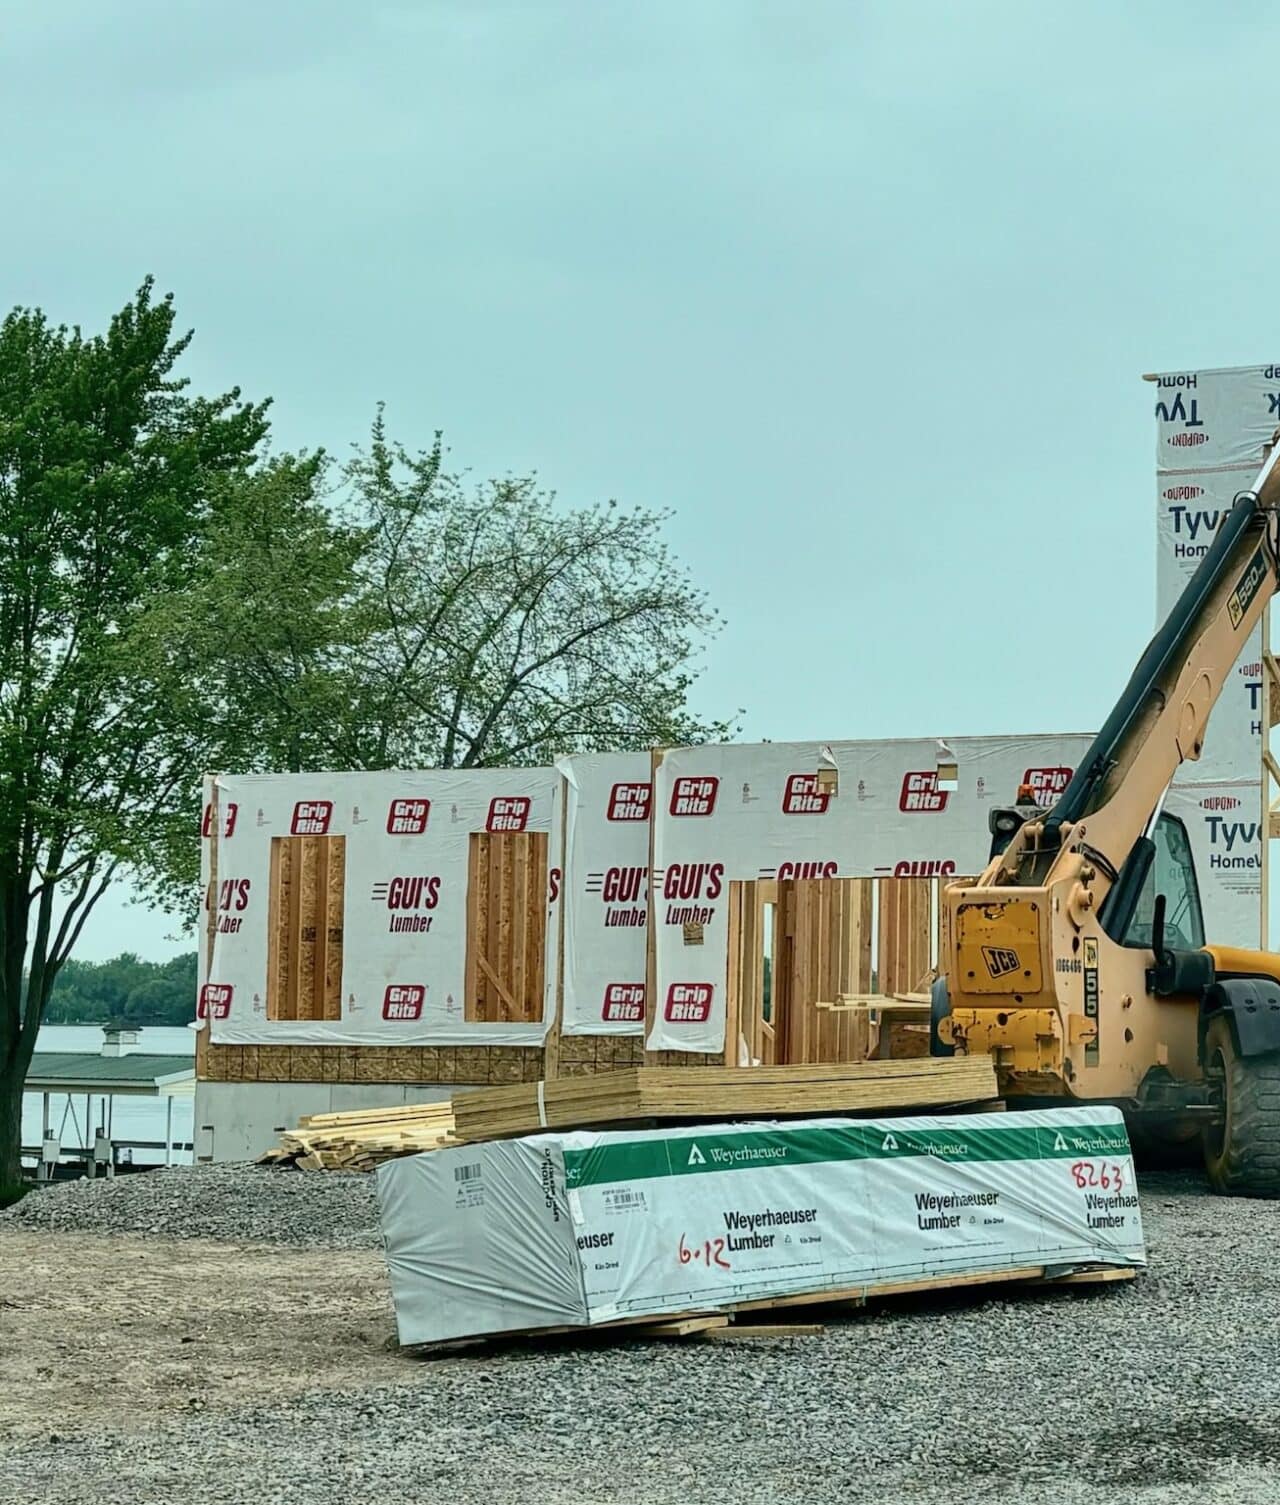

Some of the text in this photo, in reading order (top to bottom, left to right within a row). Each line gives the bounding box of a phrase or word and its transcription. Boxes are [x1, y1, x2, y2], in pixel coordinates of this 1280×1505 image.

[1167, 486, 1200, 500] DUPONT
[1168, 505, 1219, 540] Tyv
[678, 780, 713, 798] Grip
[791, 776, 818, 793] Gri
[908, 774, 939, 793] Gri
[1029, 771, 1067, 790] Grip
[615, 785, 650, 804] Grip
[789, 793, 823, 811] Rite
[906, 792, 940, 810] Rite
[1204, 796, 1237, 811] DUPONT
[298, 803, 328, 820] Grip
[395, 801, 425, 817] Grip
[494, 799, 525, 816] Grip
[612, 803, 645, 819] Rite
[675, 798, 709, 814] Rite
[295, 819, 324, 833] Rite
[392, 816, 421, 832] Rite
[491, 815, 521, 831] Rite
[1205, 816, 1262, 851] Tyv
[603, 867, 648, 902] GUI'
[664, 863, 725, 900] GUI'S
[387, 876, 441, 910] GUI'S
[389, 914, 433, 932] Lumber
[604, 906, 647, 927] Lumbe
[665, 904, 715, 925] Lumber
[988, 949, 1018, 975] JCB
[389, 988, 420, 1004] Grip
[610, 986, 644, 1004] Grip
[673, 985, 708, 1004] Grip
[387, 1003, 416, 1018] Rite
[607, 1003, 640, 1020] Rite
[670, 1003, 704, 1020] Rite
[710, 1145, 788, 1165] Weyerhaeuser
[1071, 1162, 1123, 1193] 8263
[915, 1191, 999, 1212] Weyerhaeuser
[723, 1208, 817, 1232] Weyerhaeuser
[917, 1212, 961, 1231] Lumber
[1087, 1213, 1125, 1229] Lumber
[727, 1232, 776, 1252] Lumber
